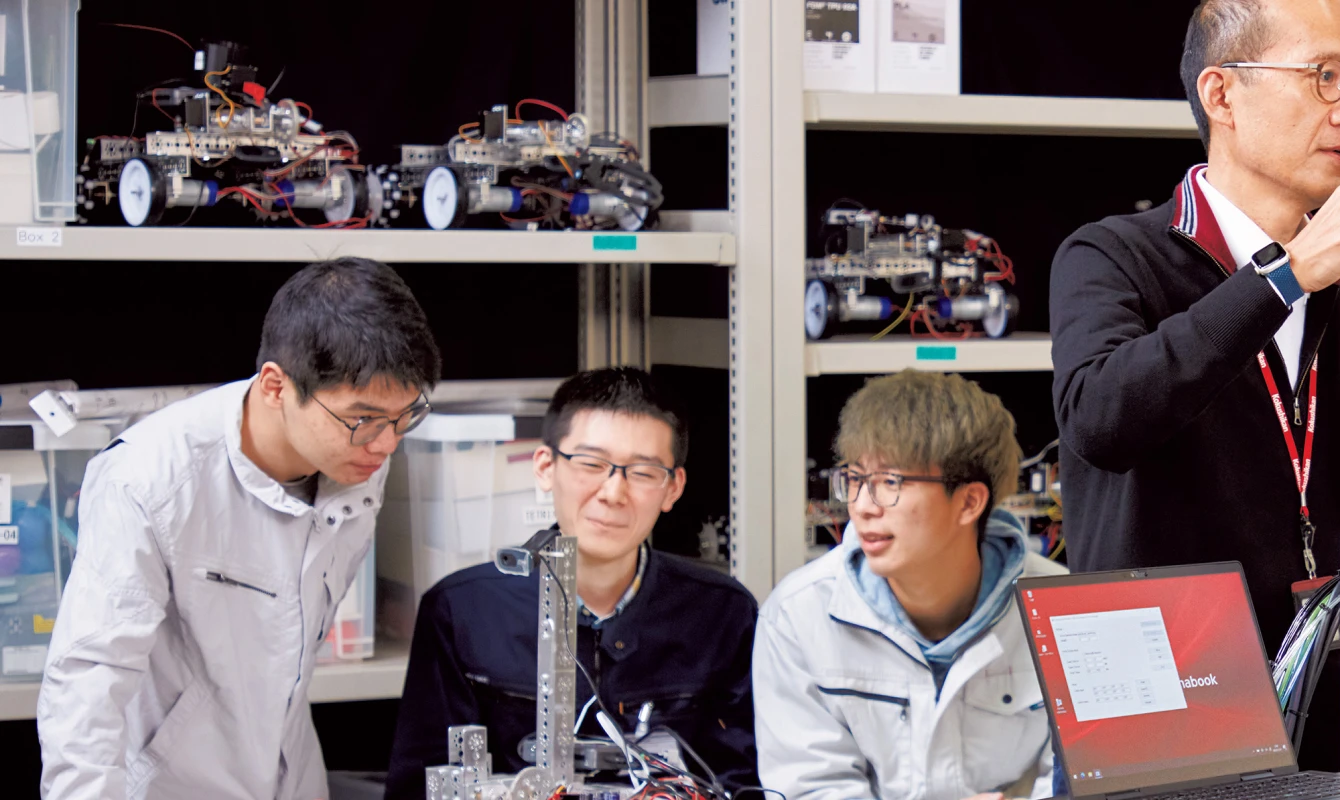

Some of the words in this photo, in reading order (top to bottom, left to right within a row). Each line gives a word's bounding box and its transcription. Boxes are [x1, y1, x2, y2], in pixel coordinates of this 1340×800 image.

[18, 231, 44, 243] Box
[51, 231, 60, 243] 2
[1271, 393, 1289, 433] Kokushikan
[1307, 395, 1317, 433] Kokushikan
